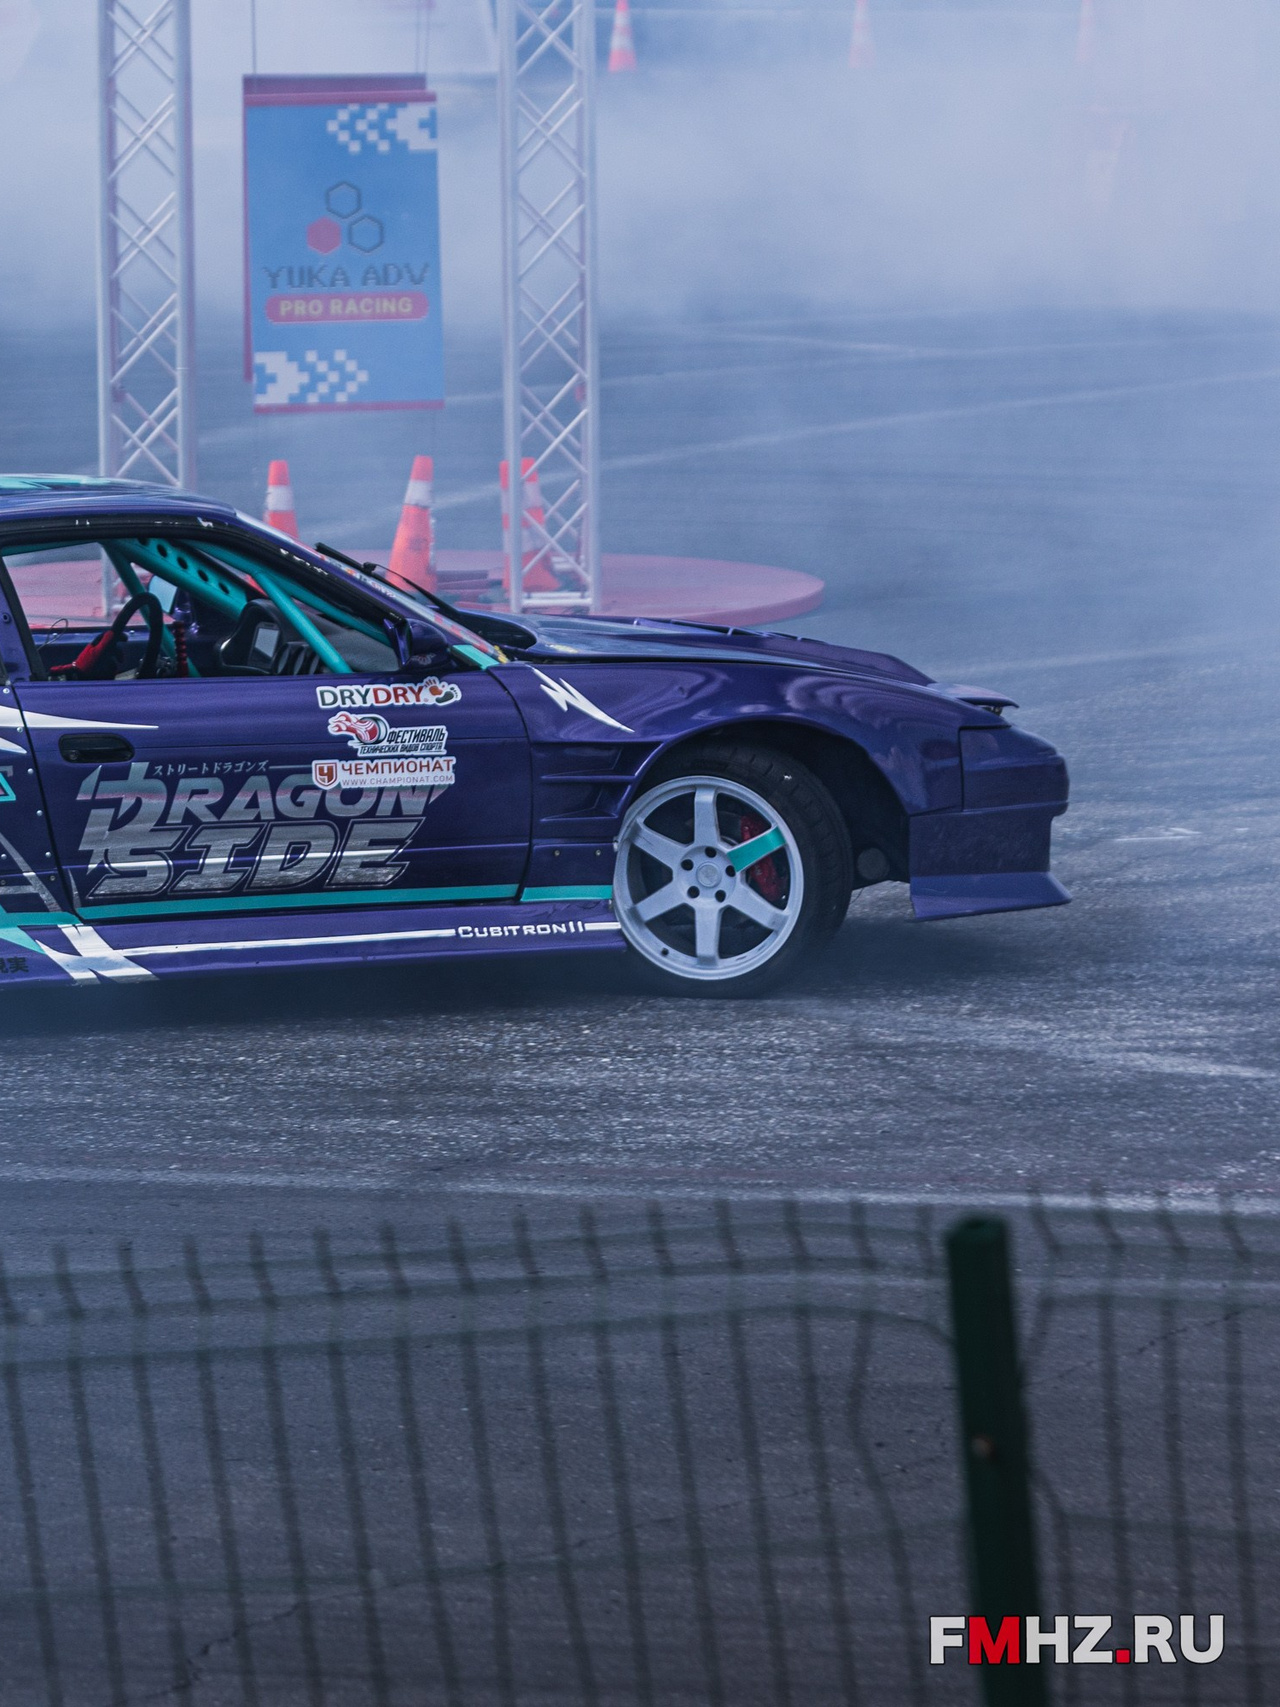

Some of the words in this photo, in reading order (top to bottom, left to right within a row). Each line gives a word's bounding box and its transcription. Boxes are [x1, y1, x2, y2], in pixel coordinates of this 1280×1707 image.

[264, 264, 351, 290] YUKA
[362, 261, 431, 287] ADV
[279, 299, 323, 317] PRO
[329, 297, 414, 316] RACING
[386, 728, 446, 744] ФЕСТИВАЛЬ
[152, 759, 269, 776] ストリートドラゴンズ
[341, 759, 454, 776] ЧЕМПИОНАТ
[342, 774, 454, 787] WWW.CHAMPIONAT.COM
[76, 761, 448, 842] DRAGON
[84, 817, 426, 899] SIDE
